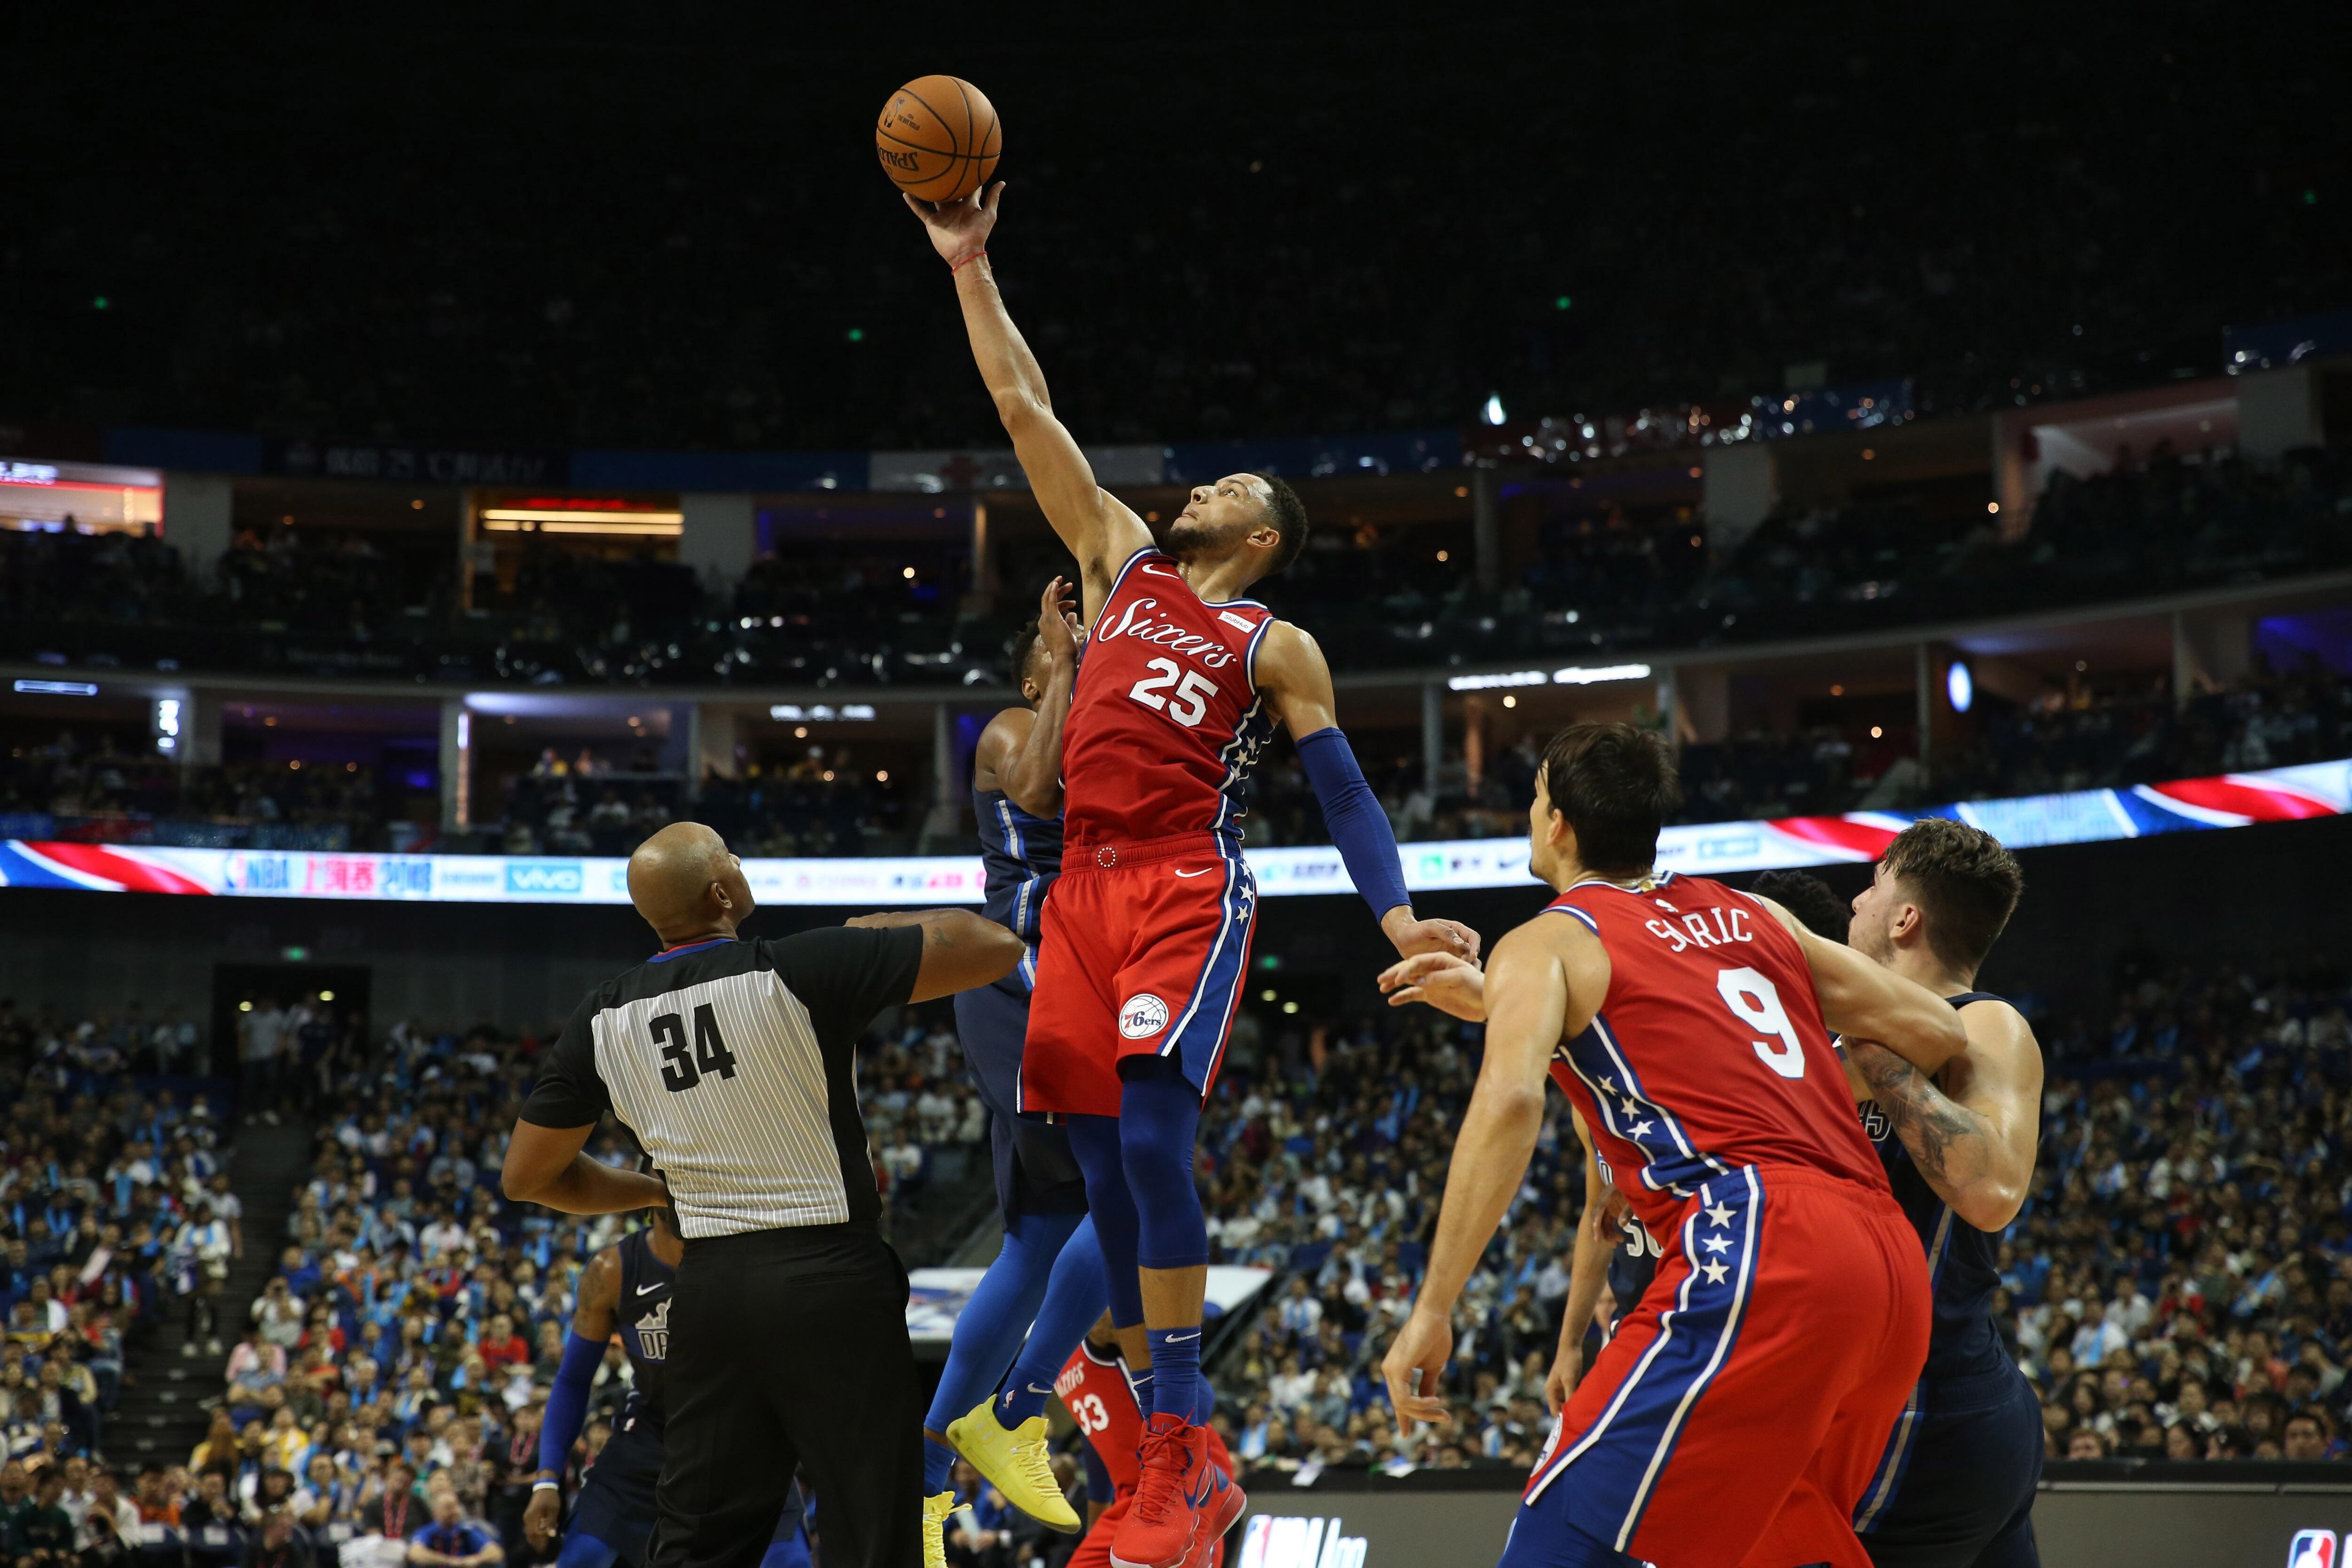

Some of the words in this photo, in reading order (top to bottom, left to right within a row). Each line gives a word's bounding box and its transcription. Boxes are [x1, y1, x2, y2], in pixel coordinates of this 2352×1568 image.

[1098, 598, 1237, 668] Sixers
[1224, 614, 1249, 629] StubHub
[1129, 657, 1219, 727] 25
[649, 1003, 736, 1093] 34
[1124, 1011, 1161, 1029] 76ers
[1716, 966, 1805, 1080] 9
[1072, 1393, 1110, 1436] 33
